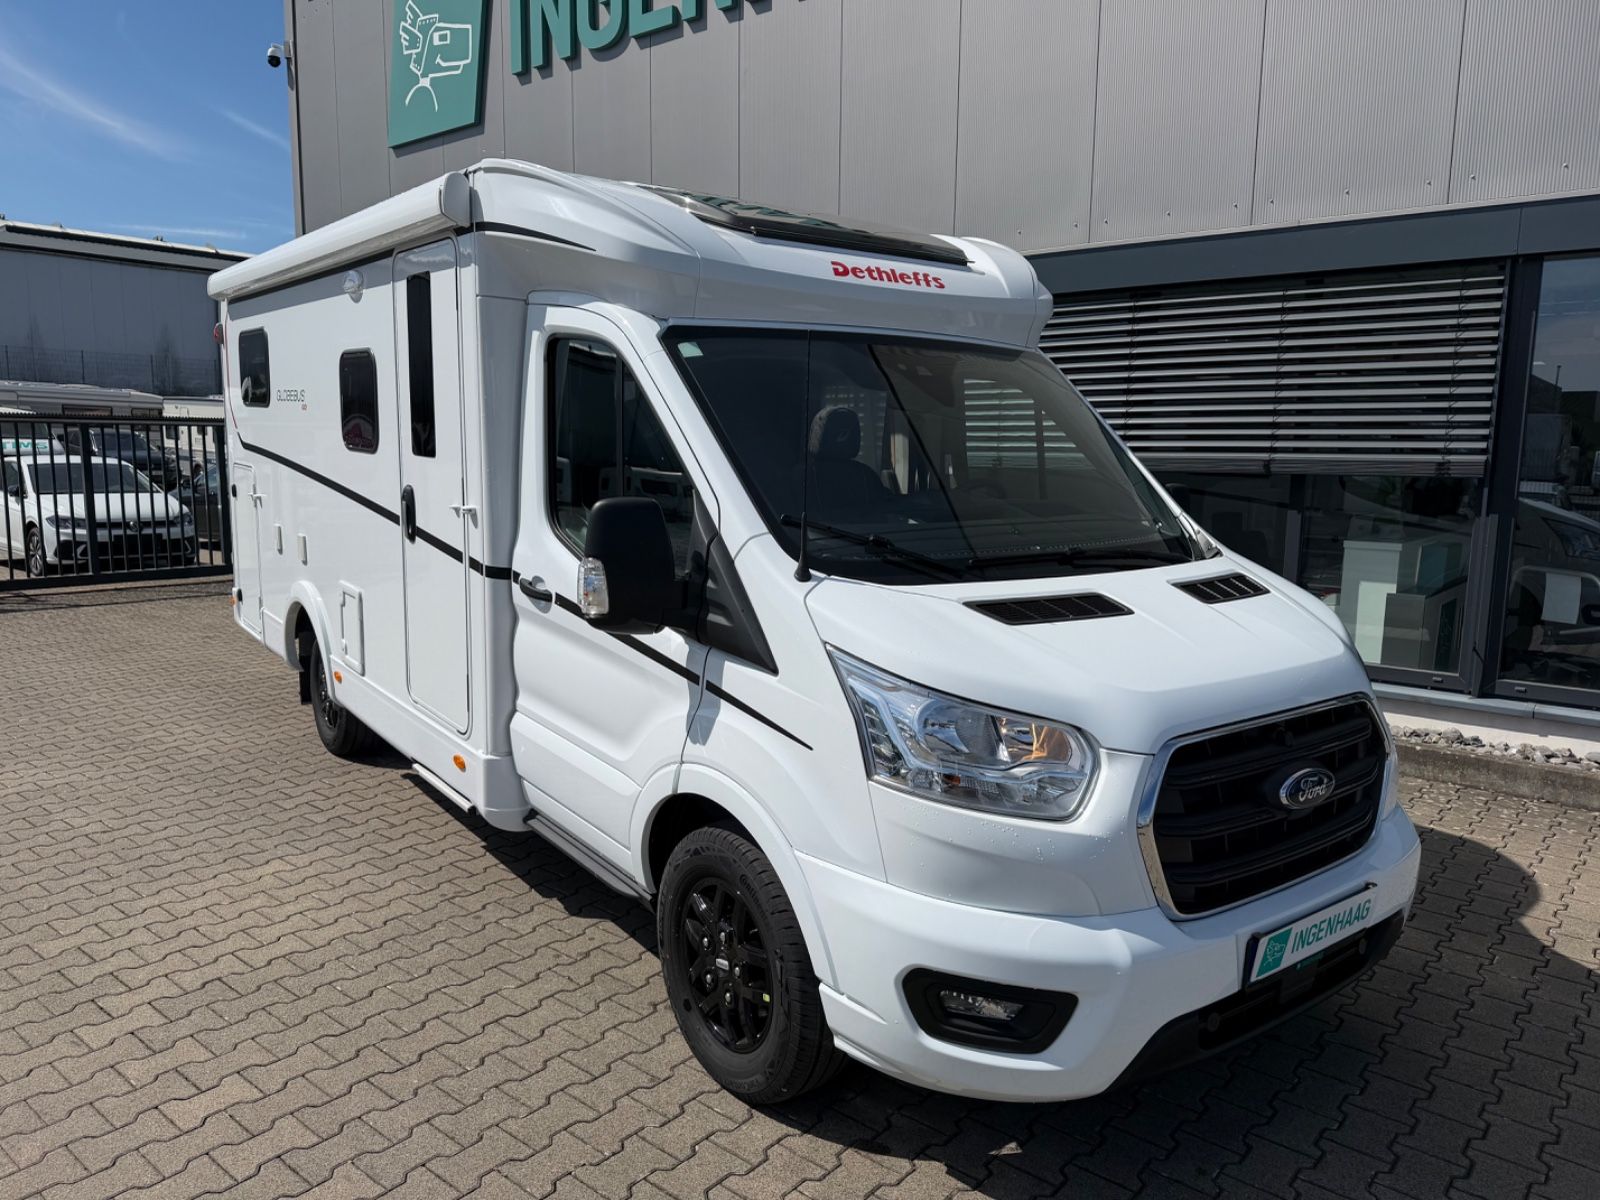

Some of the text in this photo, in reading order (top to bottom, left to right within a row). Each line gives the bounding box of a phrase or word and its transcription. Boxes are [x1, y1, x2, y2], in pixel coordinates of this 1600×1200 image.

[830, 260, 946, 290] Dethleffs
[1299, 775, 1328, 802] Ford
[1290, 898, 1372, 955] INGENHAAG
